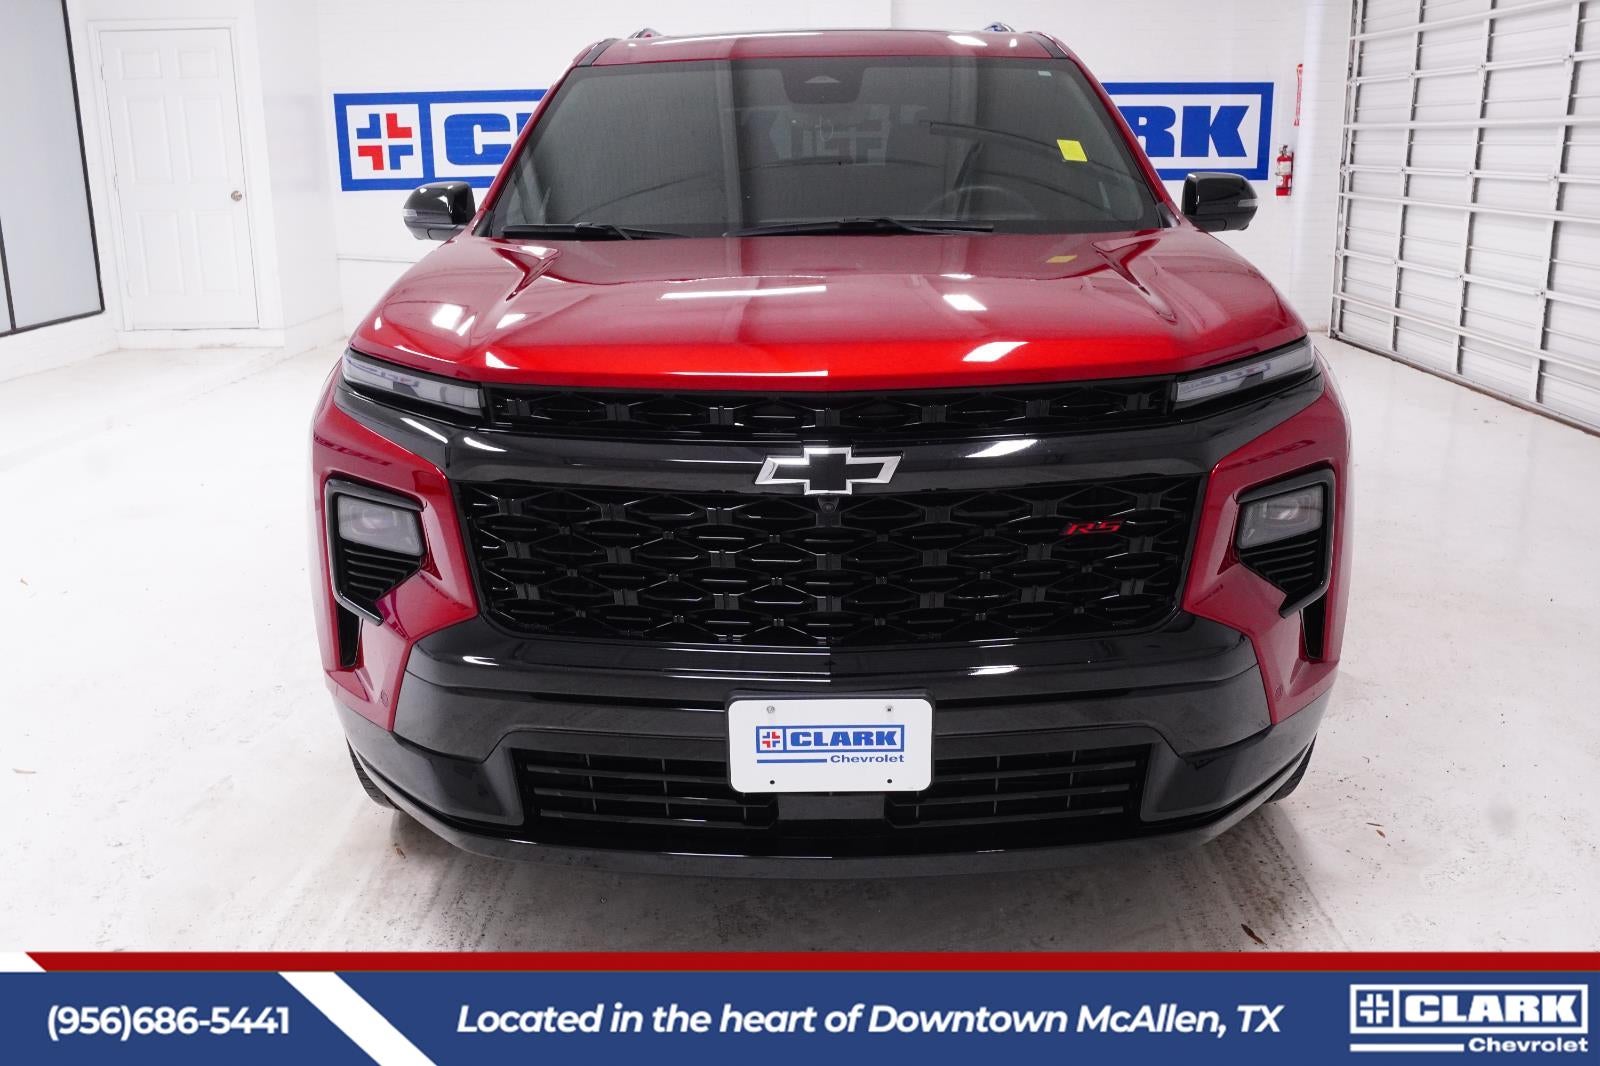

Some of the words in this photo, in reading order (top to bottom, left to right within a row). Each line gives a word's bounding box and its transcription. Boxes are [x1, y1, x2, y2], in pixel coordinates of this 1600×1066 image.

[1064, 521, 1121, 535] RS
[790, 730, 897, 746] CLARK
[830, 754, 904, 763] Chevrolet
